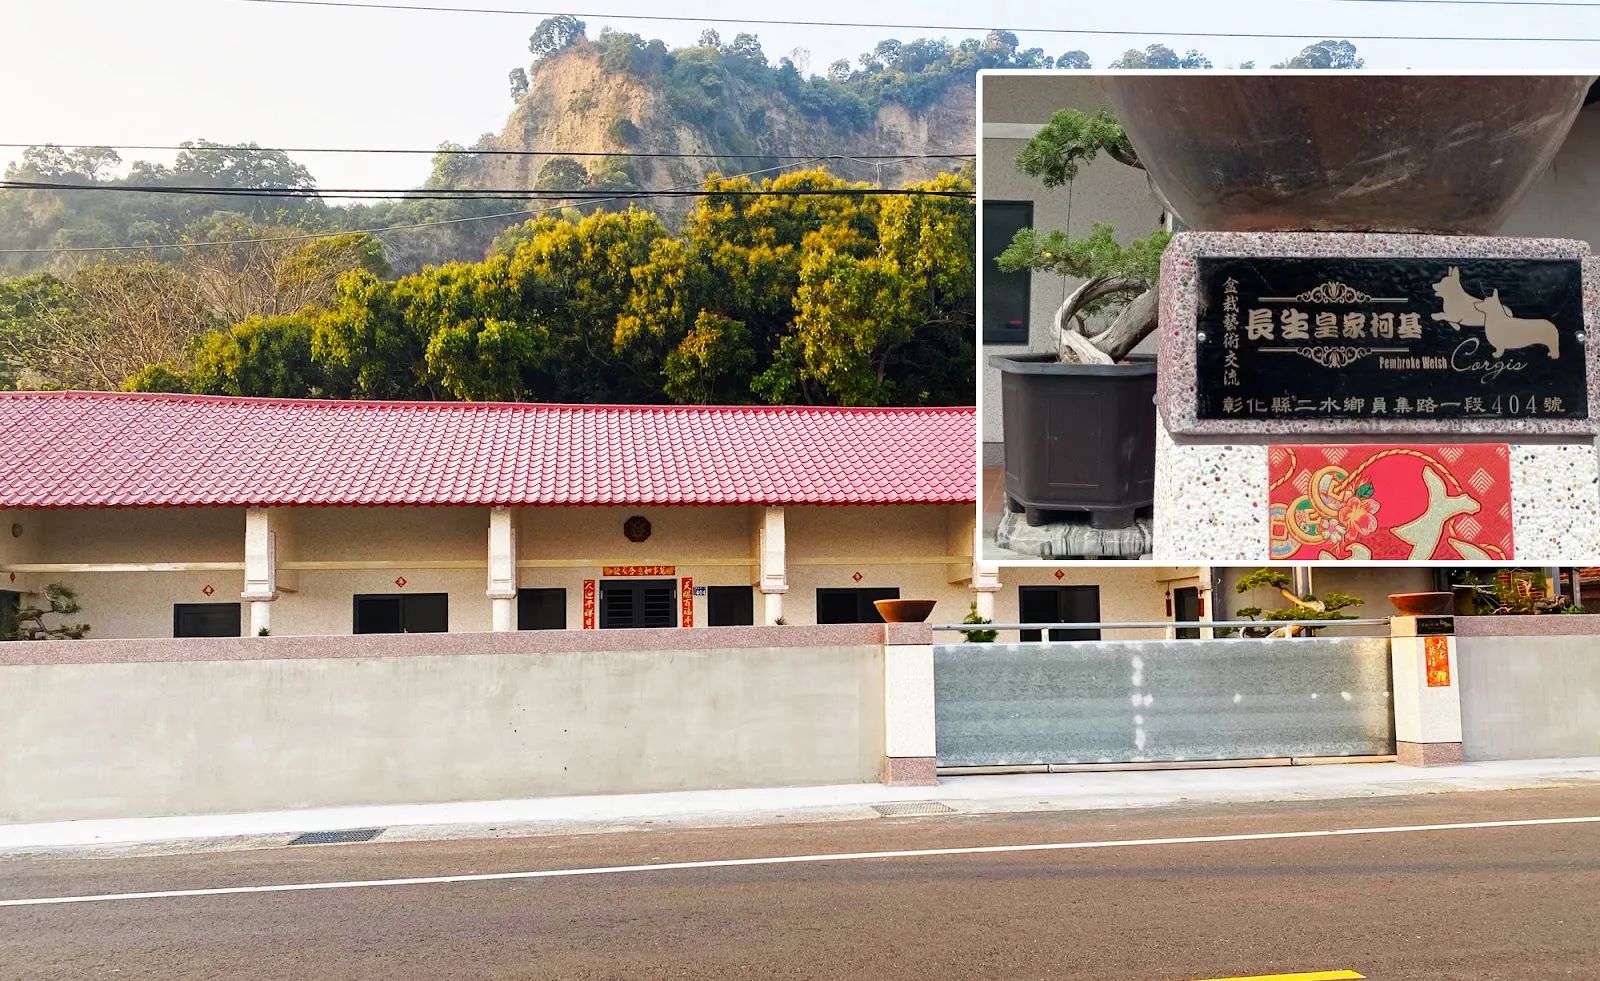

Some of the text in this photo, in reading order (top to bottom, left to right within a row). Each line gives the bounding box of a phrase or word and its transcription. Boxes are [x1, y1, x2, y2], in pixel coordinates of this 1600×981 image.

[1222, 276, 1240, 387] 盆栽藝術交流
[1245, 307, 1423, 341] 長生皇家柯基
[1379, 337, 1528, 385] Pembroke Welsh Corgis
[1222, 393, 1566, 415] 彰化縣二水鄉員集路一段404號
